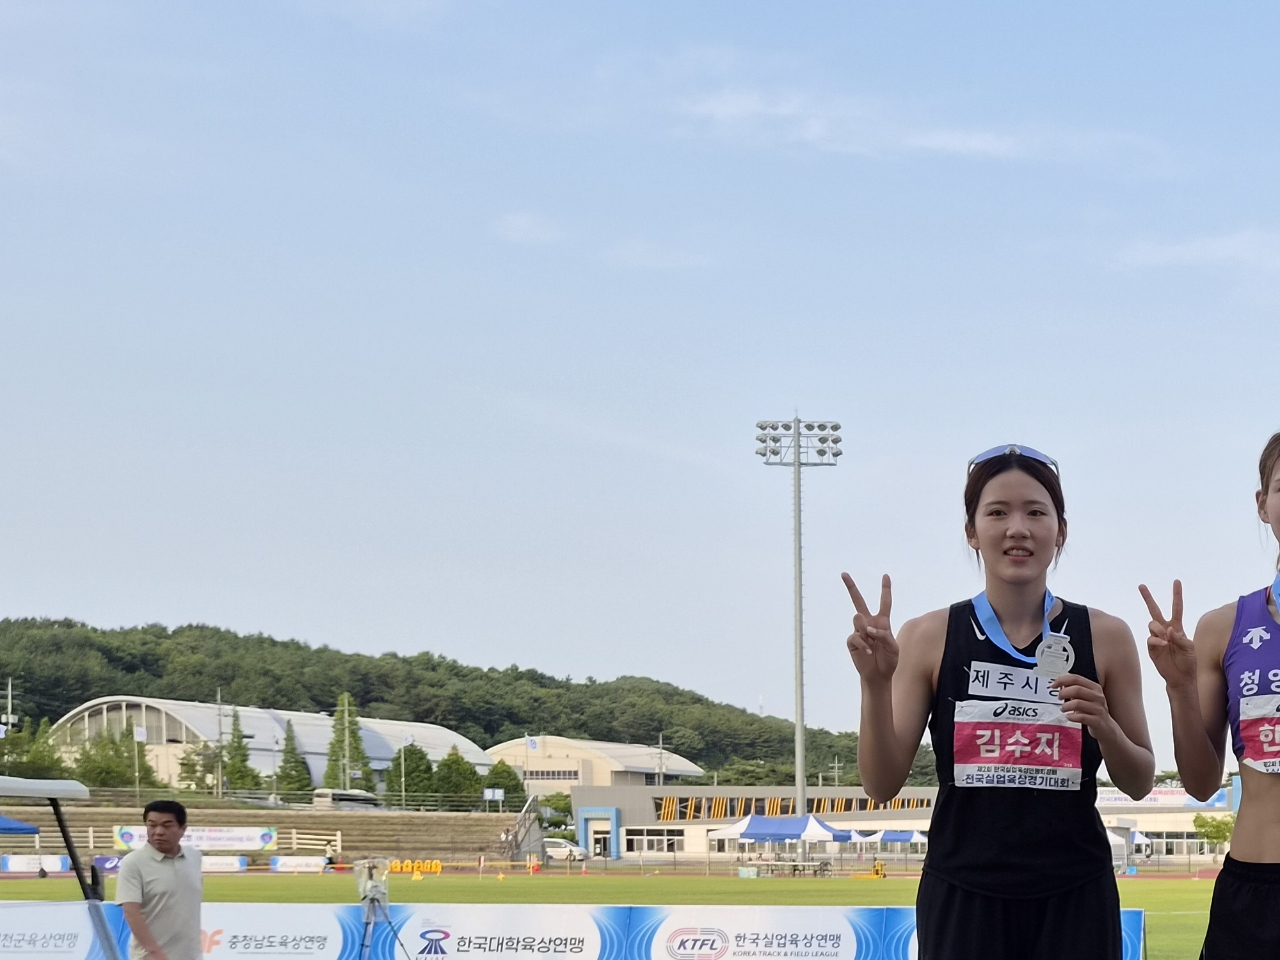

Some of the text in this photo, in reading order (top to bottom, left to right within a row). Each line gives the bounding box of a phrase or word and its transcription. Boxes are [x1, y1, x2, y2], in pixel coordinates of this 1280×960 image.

[976, 729, 1060, 760] 김수지
[965, 774, 1070, 788] 전국실업육상경기대회
[0, 932, 79, 949] 천군육상연맹
[228, 935, 328, 950] 충청남도육상연맹
[456, 936, 585, 953] 한국대학육상연맹
[677, 938, 719, 951] KTFL
[734, 933, 842, 948] 한국실업육상연맹
